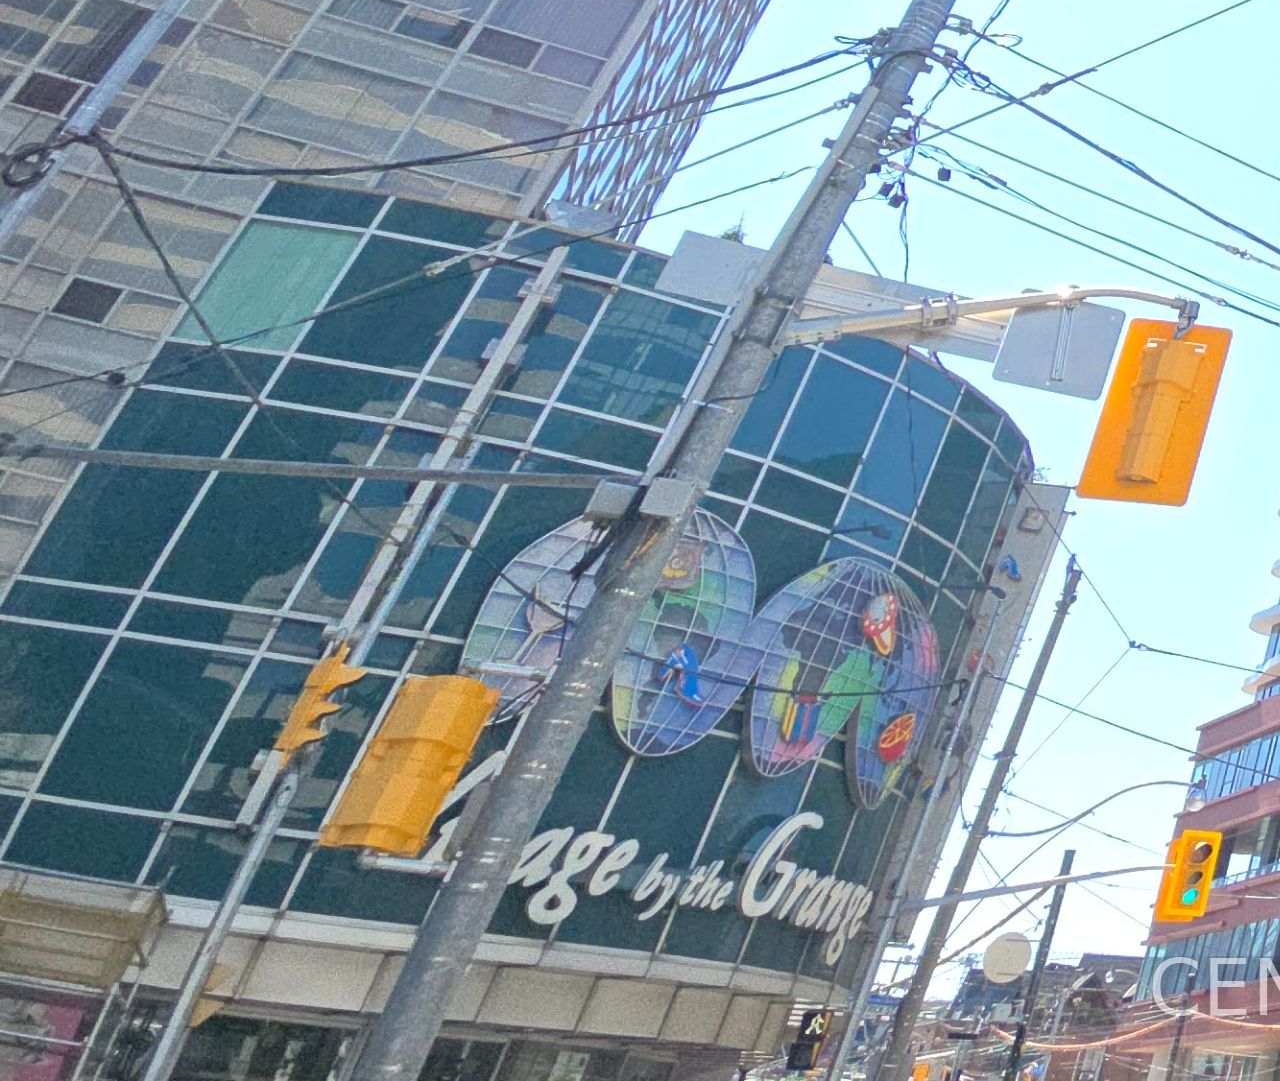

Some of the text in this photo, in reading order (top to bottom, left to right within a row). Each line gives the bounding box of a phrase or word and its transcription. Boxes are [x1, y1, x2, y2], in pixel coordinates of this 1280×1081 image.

[632, 852, 679, 921] by
[678, 860, 735, 911] the
[740, 811, 874, 967] Grange
